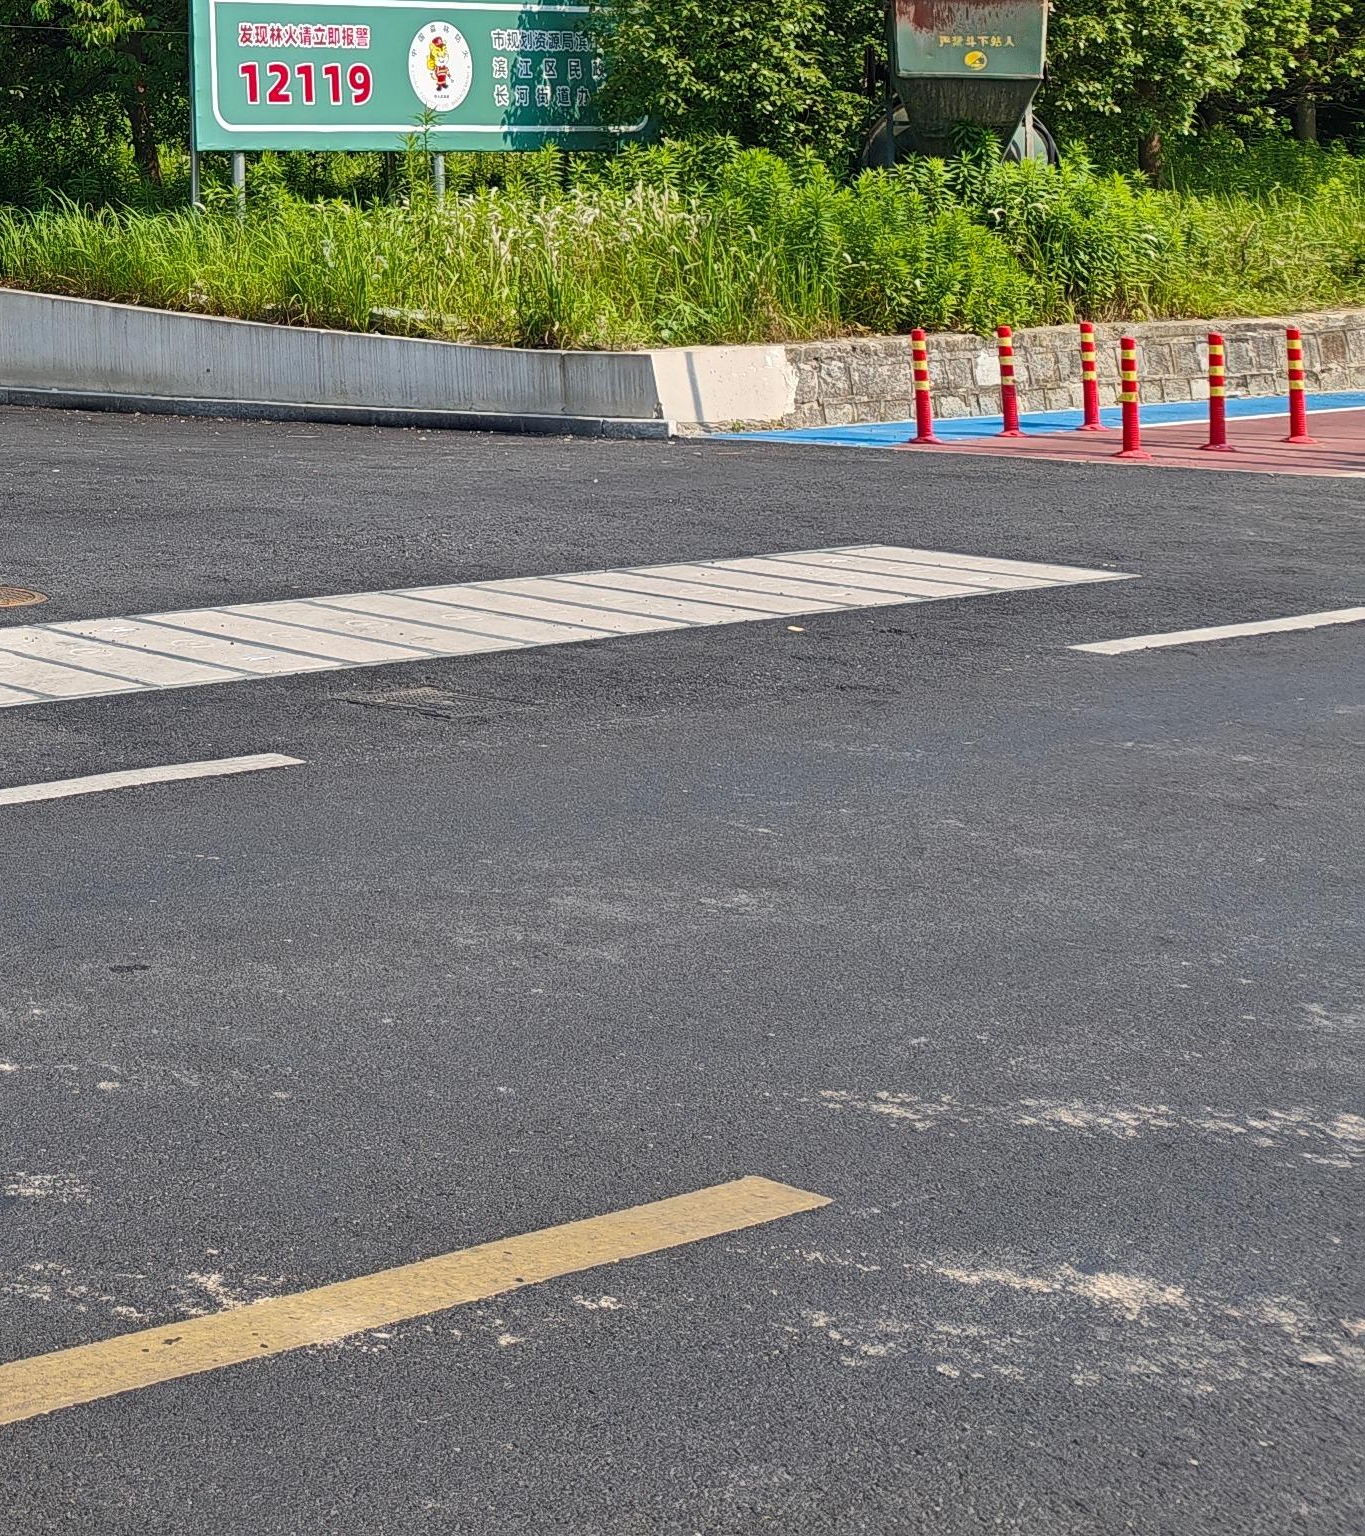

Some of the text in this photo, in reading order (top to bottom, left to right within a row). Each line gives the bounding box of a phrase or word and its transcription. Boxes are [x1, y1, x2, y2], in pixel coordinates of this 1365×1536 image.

[239, 24, 369, 47] 发现林火请立即报警
[491, 30, 595, 52] 市规划资源局滨
[240, 62, 372, 105] 12119
